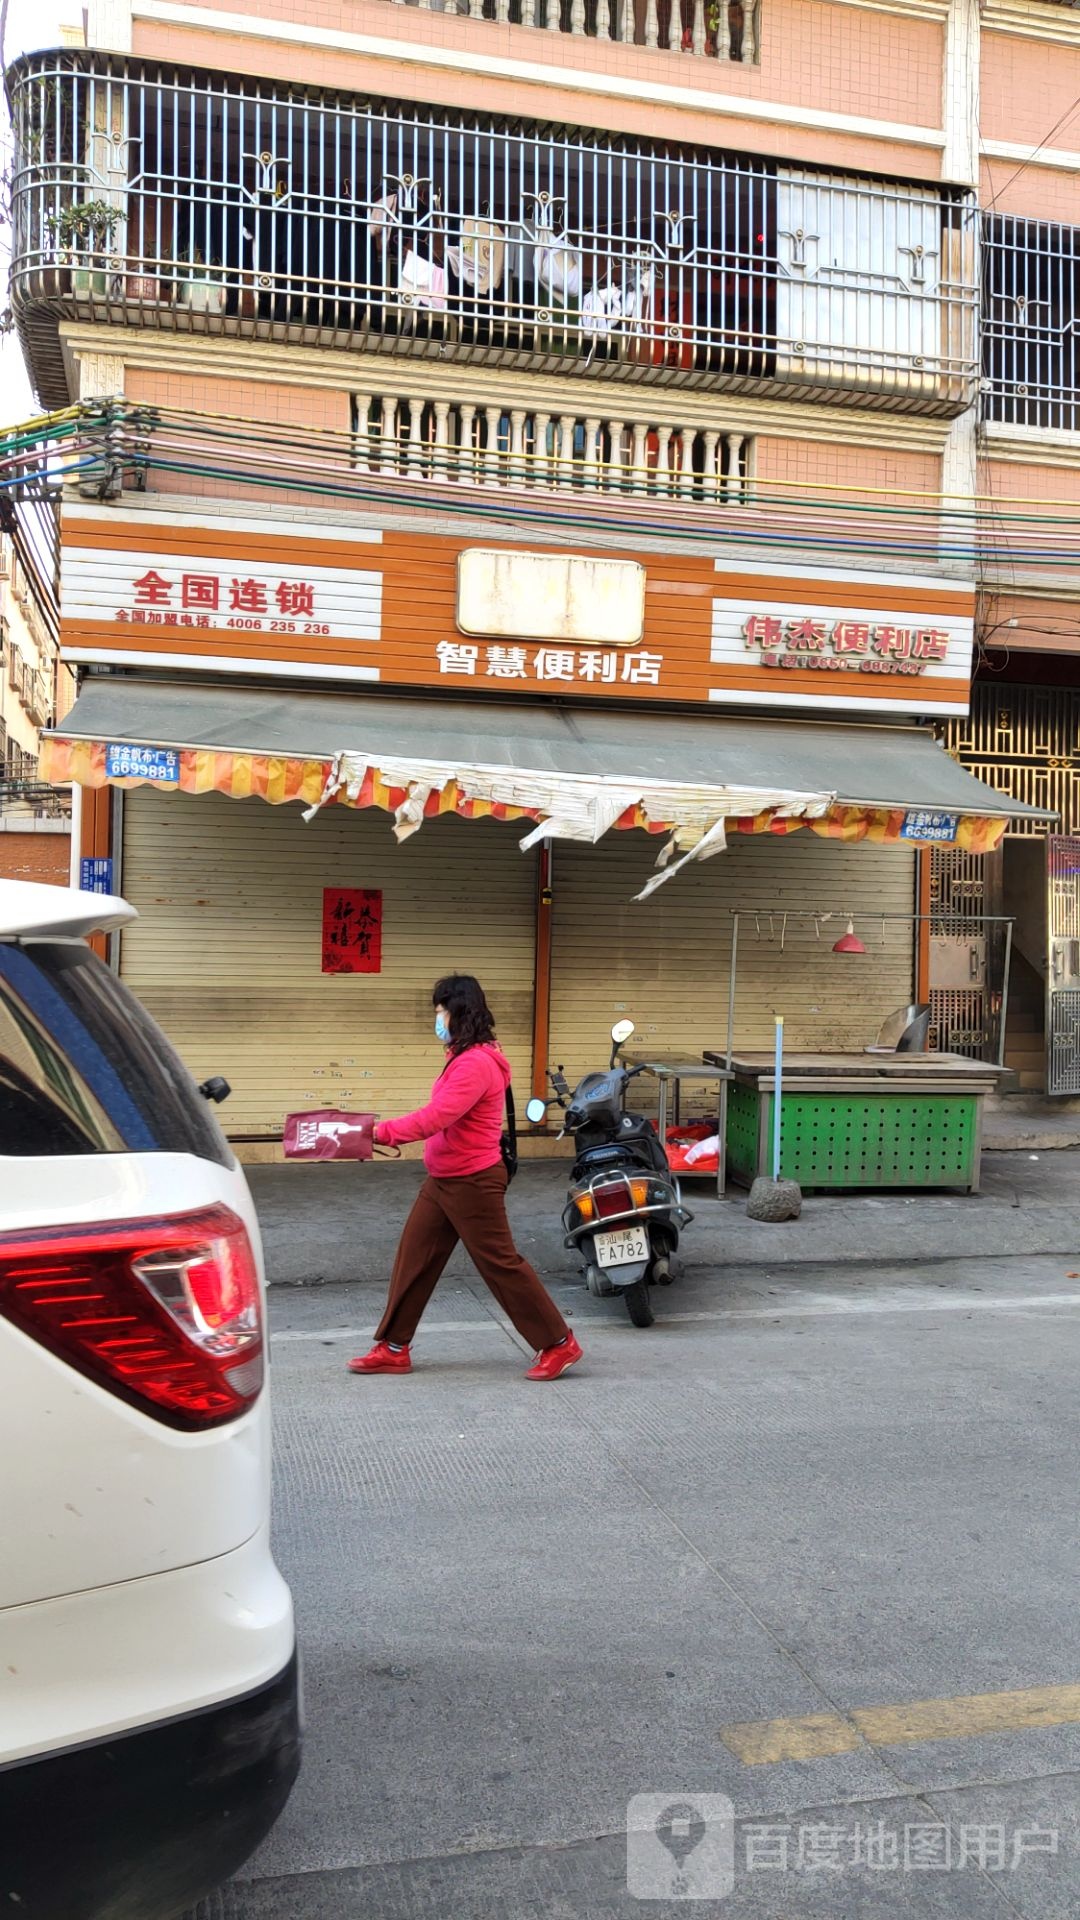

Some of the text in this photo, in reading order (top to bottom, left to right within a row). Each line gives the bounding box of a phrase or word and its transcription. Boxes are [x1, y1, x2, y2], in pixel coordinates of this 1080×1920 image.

[133, 571, 315, 617] 全国连锁
[227, 618, 262, 631] 4006
[270, 620, 296, 633] 235
[304, 622, 330, 635] 236
[742, 615, 950, 660] 伟杰便利店
[435, 640, 663, 685] 智慧便利店
[112, 761, 175, 778] 6699881
[598, 1242, 645, 1262] FA782
